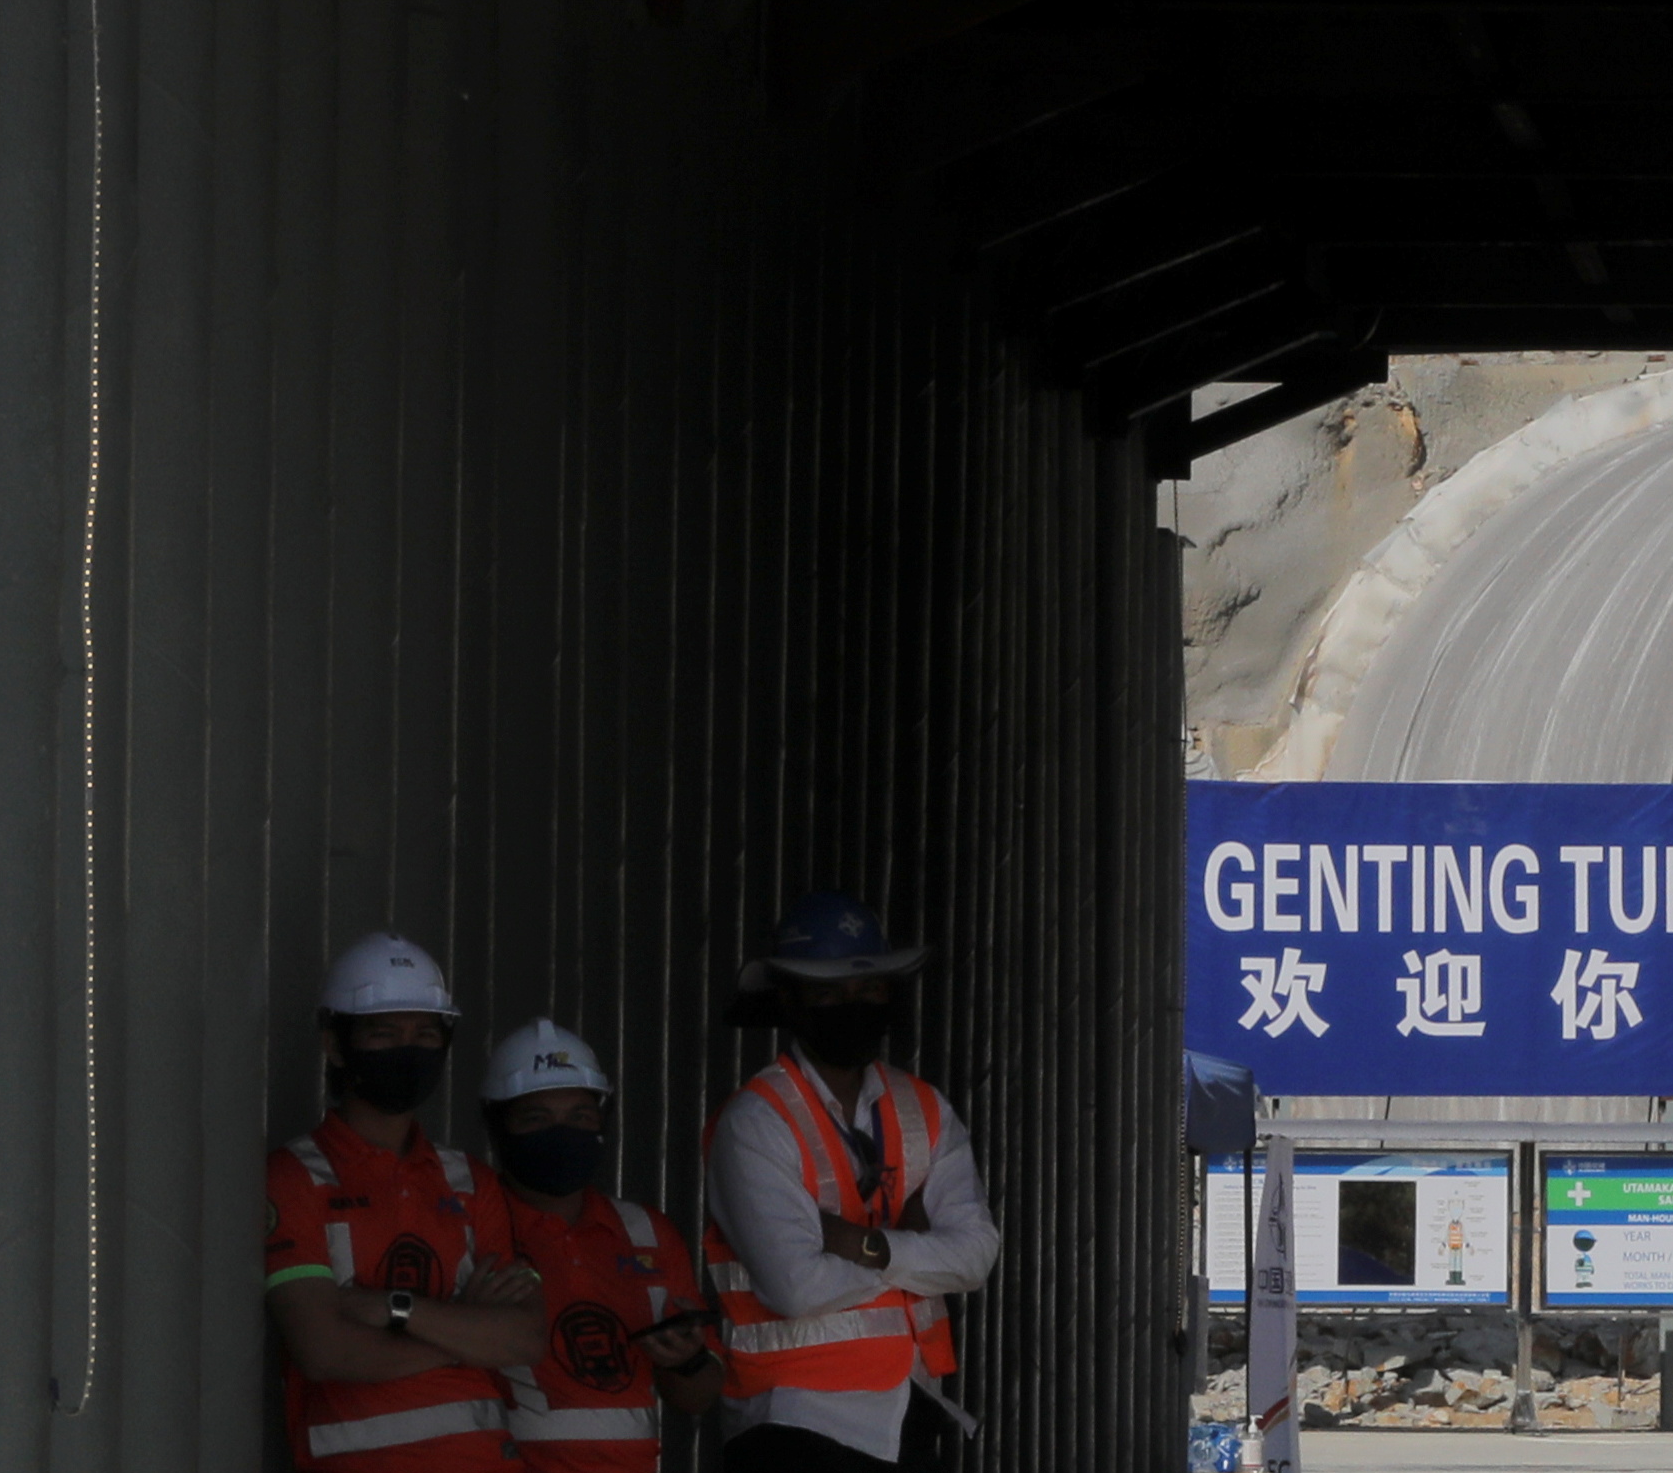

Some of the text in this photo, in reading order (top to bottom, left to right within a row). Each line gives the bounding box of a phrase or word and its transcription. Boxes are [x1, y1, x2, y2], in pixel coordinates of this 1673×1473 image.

[1204, 842, 1539, 933] GENTING
[1238, 948, 1642, 1039] 欢迎你
[1623, 1232, 1651, 1241] YEAR
[1623, 1252, 1663, 1262] MONTH
[1624, 1271, 1649, 1280] TOTAL
[1623, 1281, 1652, 1289] WORKS
[1654, 1281, 1665, 1289] TO
